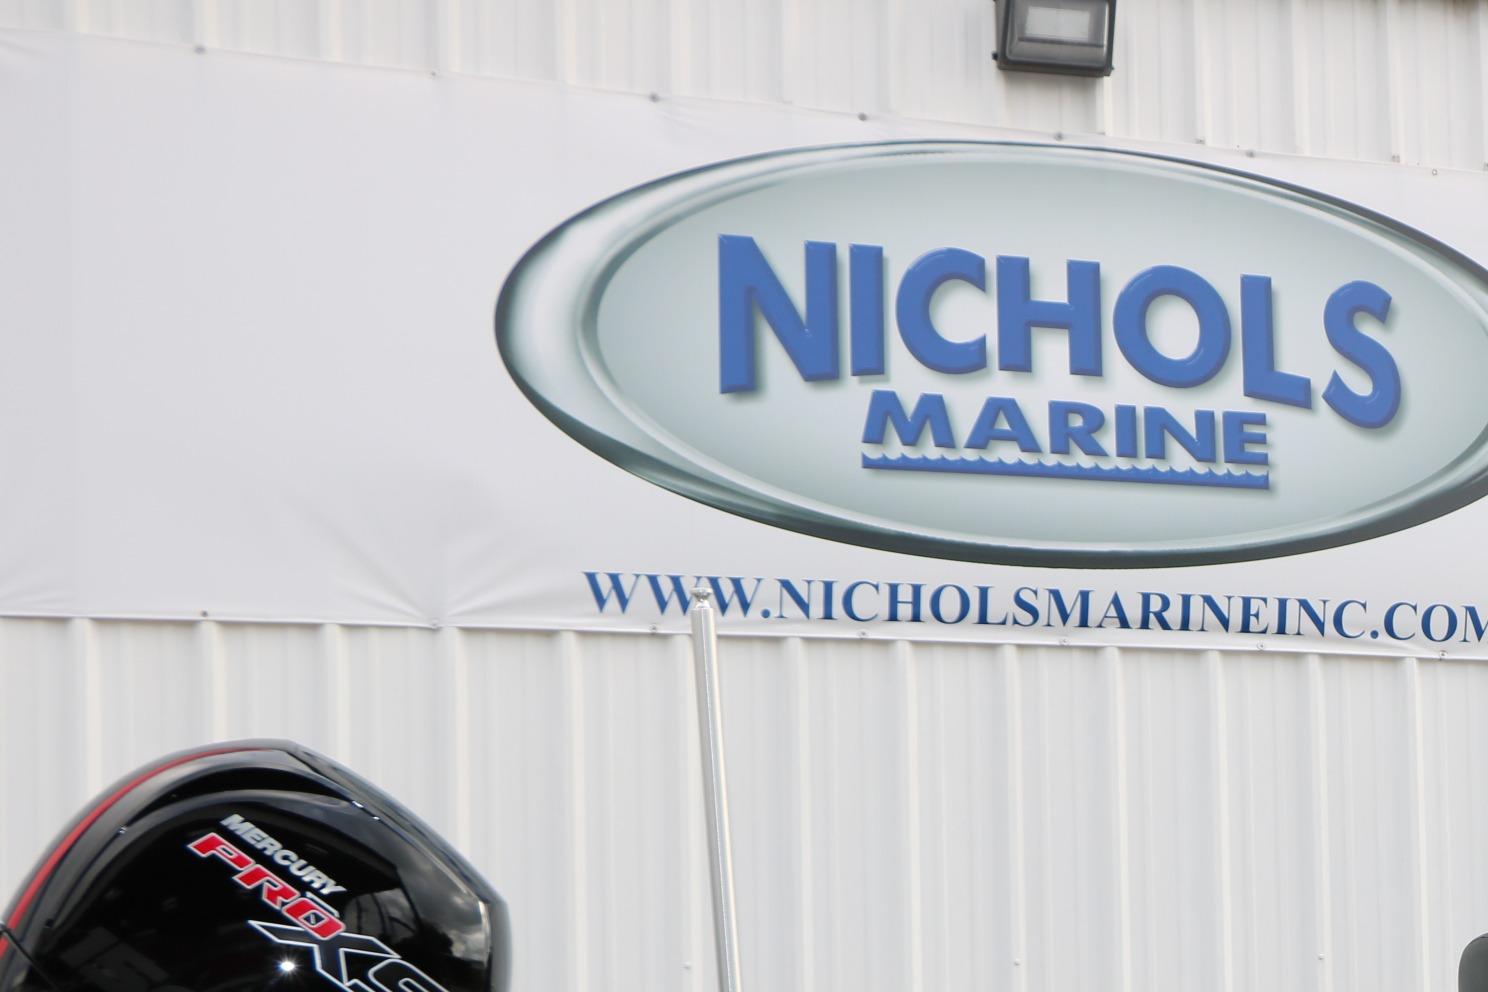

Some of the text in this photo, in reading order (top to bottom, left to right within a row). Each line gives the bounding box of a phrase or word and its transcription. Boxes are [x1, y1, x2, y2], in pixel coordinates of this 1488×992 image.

[718, 234, 1402, 429] NICHOLS
[862, 389, 1270, 466] MARINE
[187, 832, 346, 940] PRO
[220, 813, 347, 896] MERCURY
